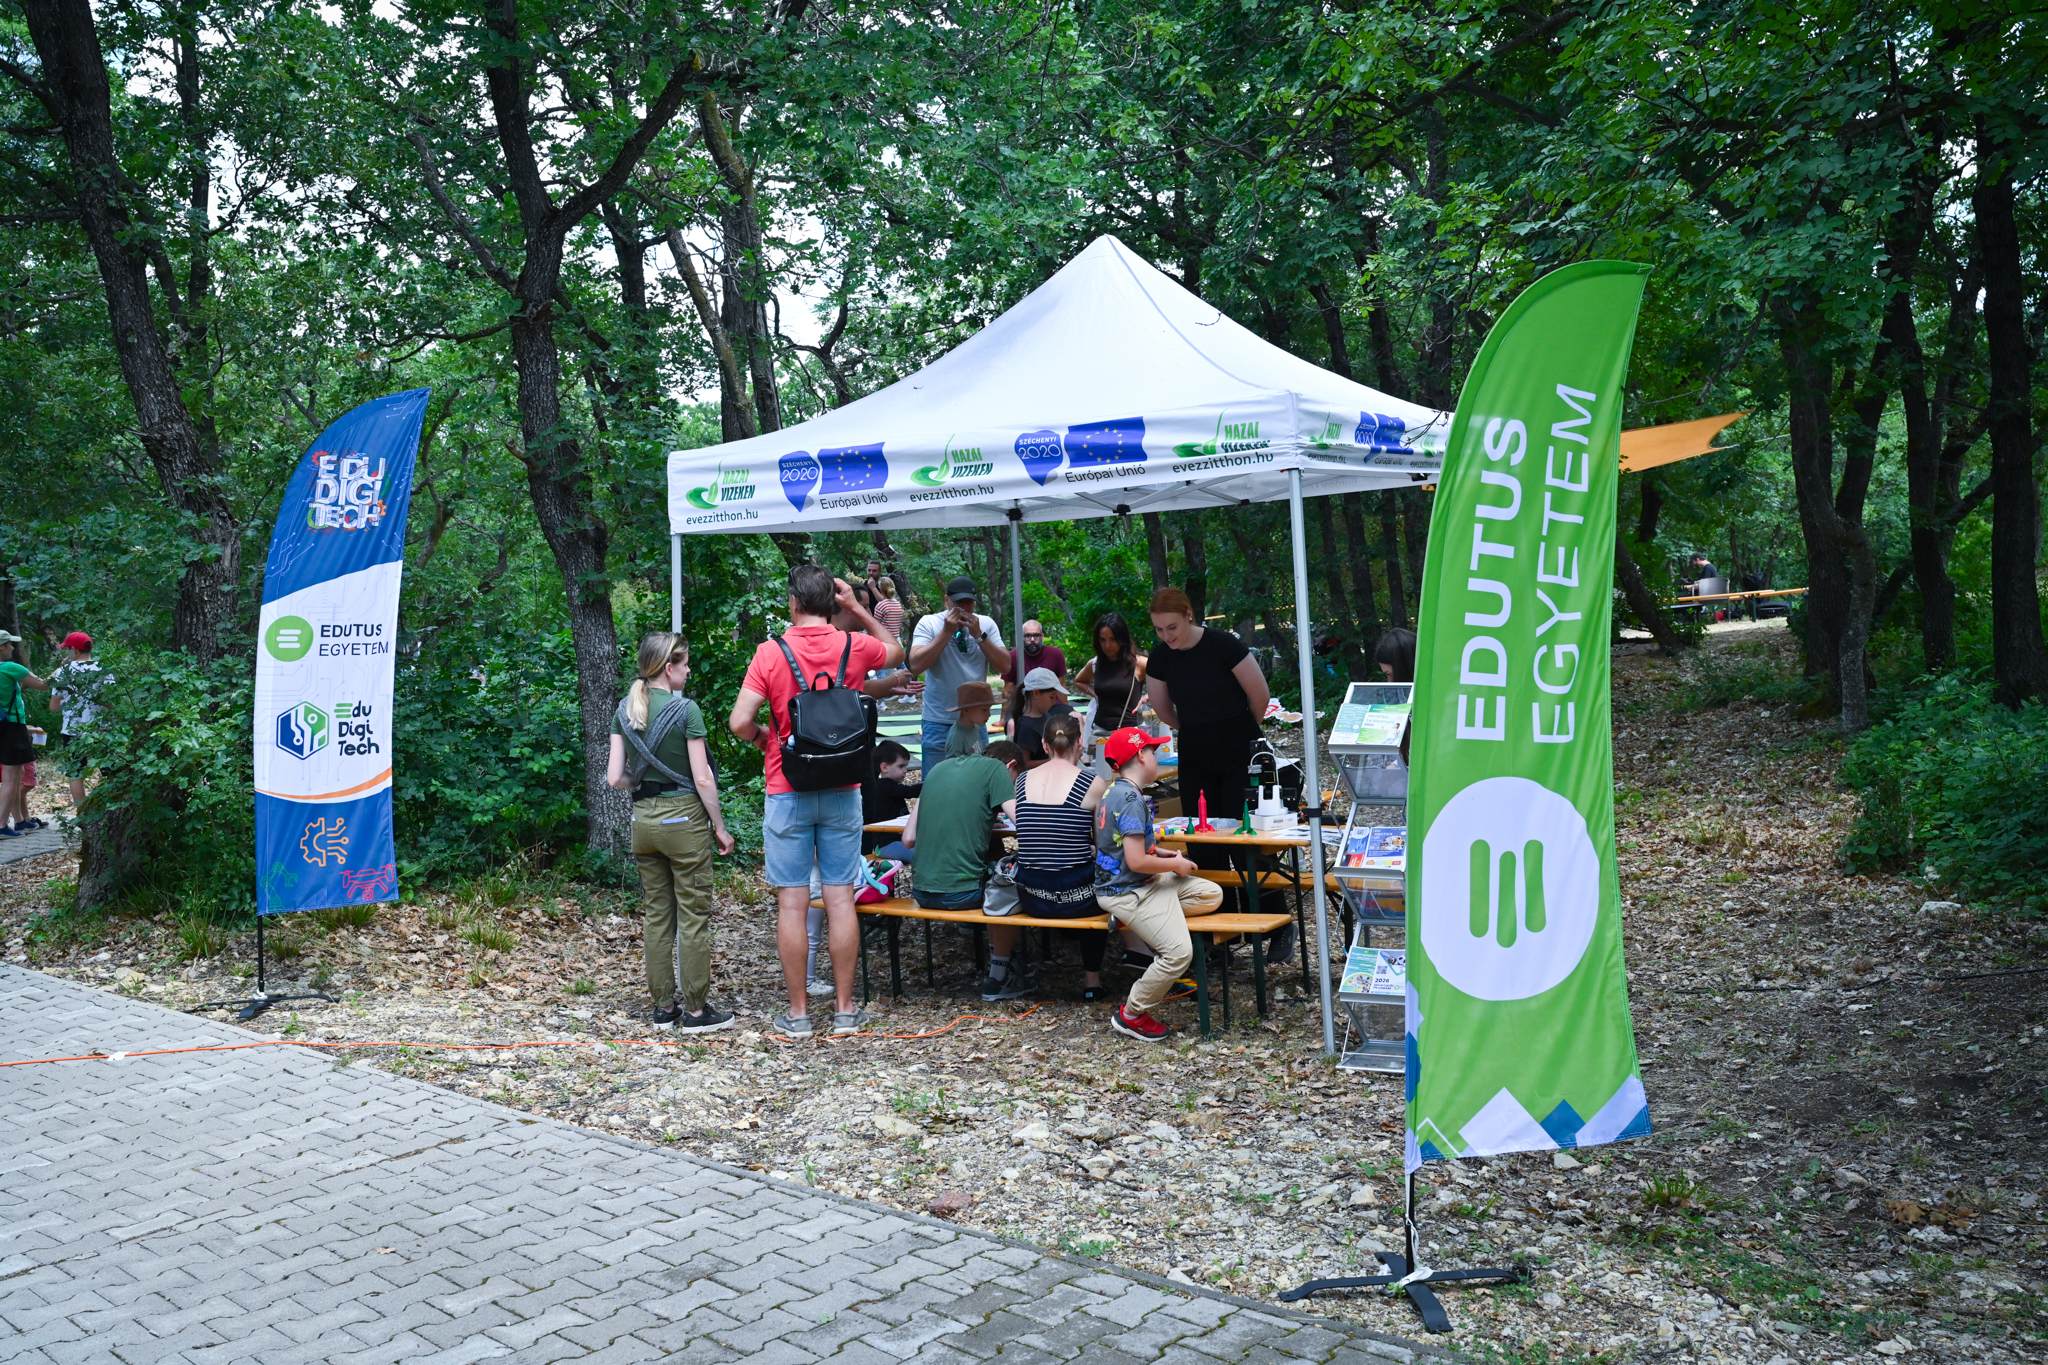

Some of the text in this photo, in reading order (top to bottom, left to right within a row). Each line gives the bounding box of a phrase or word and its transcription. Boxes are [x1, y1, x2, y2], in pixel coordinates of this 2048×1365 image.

[1224, 421, 1259, 441] HAZAI
[1019, 436, 1057, 445] SZÉCHENYI
[951, 447, 983, 464] HAZAI
[1018, 444, 1061, 459] 2020
[319, 455, 386, 480] EDU
[782, 460, 814, 468] SZÉCHENYI
[950, 462, 994, 478] VIZEKEN
[1172, 452, 1274, 473] evezzitthon.hu
[722, 469, 750, 485] HAZAI
[782, 467, 818, 482] 2020
[1065, 464, 1146, 483] Európai Unió
[315, 478, 382, 505] DIGI
[721, 485, 756, 501] VIZEKEN
[910, 484, 995, 502] evezzitthon.hu
[820, 492, 888, 509] Európai Unió
[309, 503, 380, 529] TECH
[686, 508, 758, 525] evezzitthon.hu
[1532, 383, 1597, 743] EGYETEM
[1456, 417, 1527, 741] EDUTUS
[320, 624, 382, 638] EDUTUS
[319, 641, 389, 656] EGYETEM
[334, 700, 372, 718] Edu
[338, 719, 373, 741] Digi
[338, 737, 380, 756] Tech
